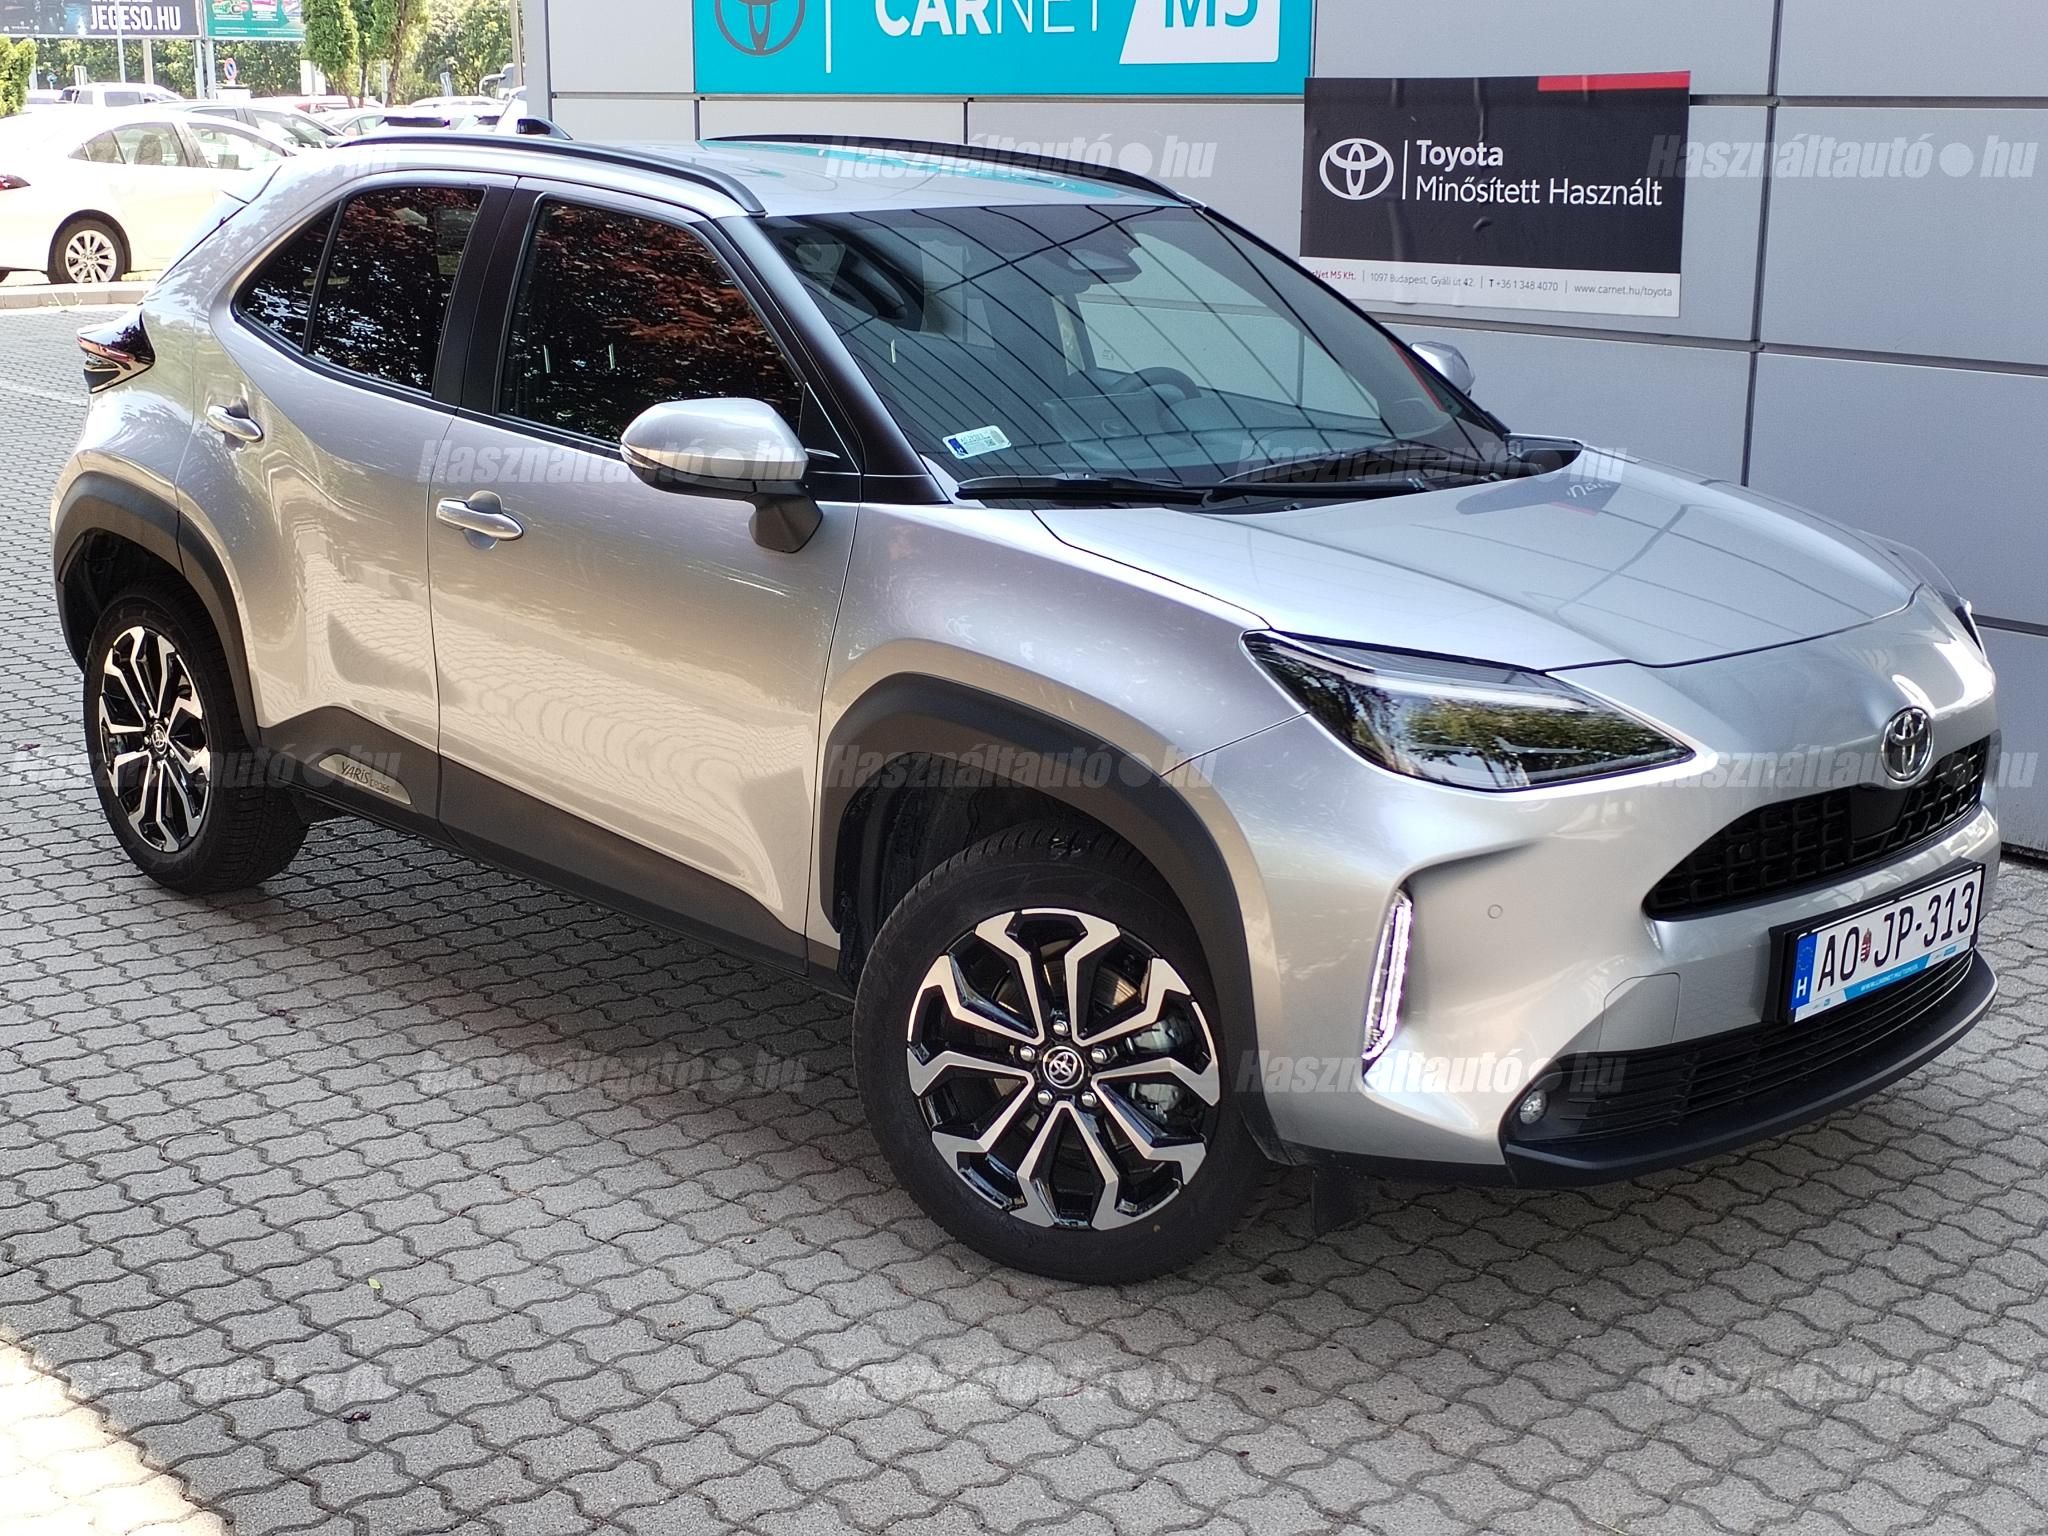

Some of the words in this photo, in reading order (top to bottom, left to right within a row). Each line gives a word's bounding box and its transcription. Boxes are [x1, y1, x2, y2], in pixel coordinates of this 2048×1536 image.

[1416, 139, 1504, 172] Toyota
[1416, 175, 1541, 204] Minősített
[1549, 177, 1662, 206] Használt
[1370, 272, 1388, 282] 1097
[1489, 278, 1494, 288] T
[1519, 280, 1535, 290] 348
[1537, 281, 1558, 291] 4070
[1574, 284, 1673, 298] www.carnet.hu/toyota
[1817, 926, 1860, 992] AO
[1795, 979, 1806, 998] H
